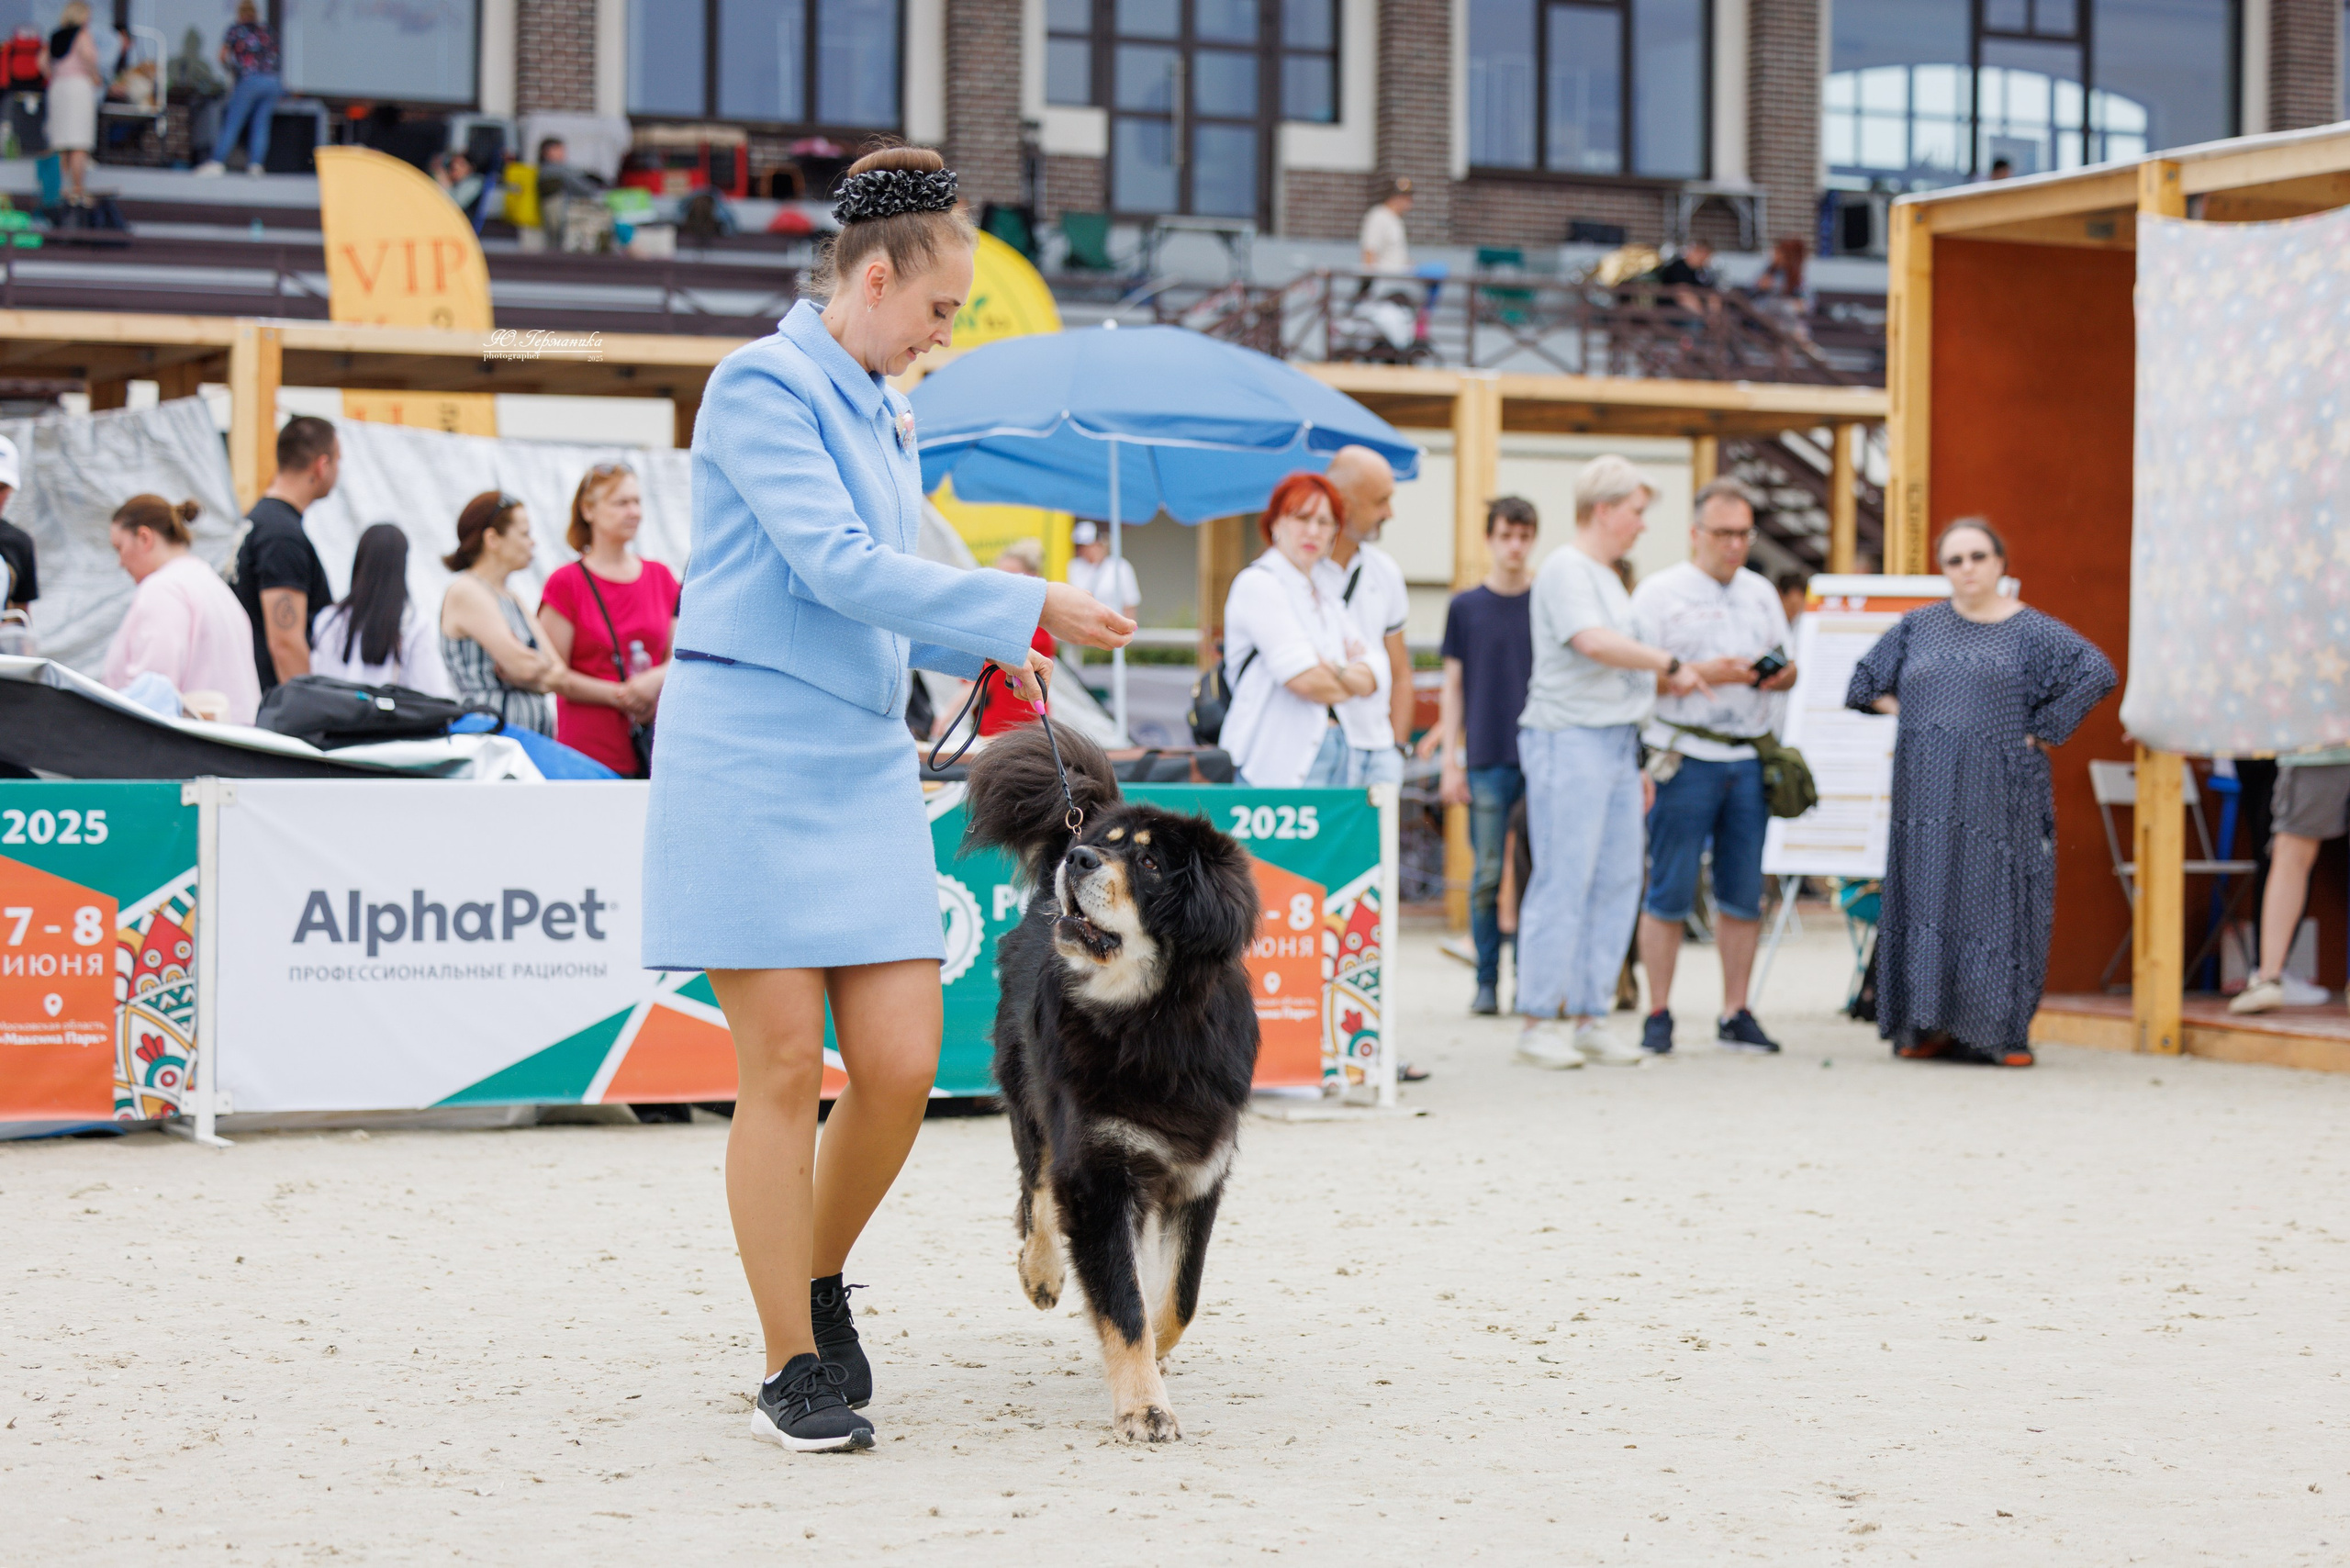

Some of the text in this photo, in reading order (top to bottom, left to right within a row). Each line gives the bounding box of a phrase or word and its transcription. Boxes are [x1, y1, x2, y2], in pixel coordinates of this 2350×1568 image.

[341, 236, 468, 296] VIP
[1, 809, 109, 845] 2025
[1230, 805, 1319, 839] 2025
[4, 906, 34, 946] 7
[73, 905, 104, 946] 8
[291, 887, 607, 958] AlphaPet
[1288, 892, 1315, 931] 8
[1244, 935, 1315, 958] ЮНЯ
[289, 963, 608, 982] ПРОФЕССИОНАЛЬНЫЕ РАЦИОНЫ
